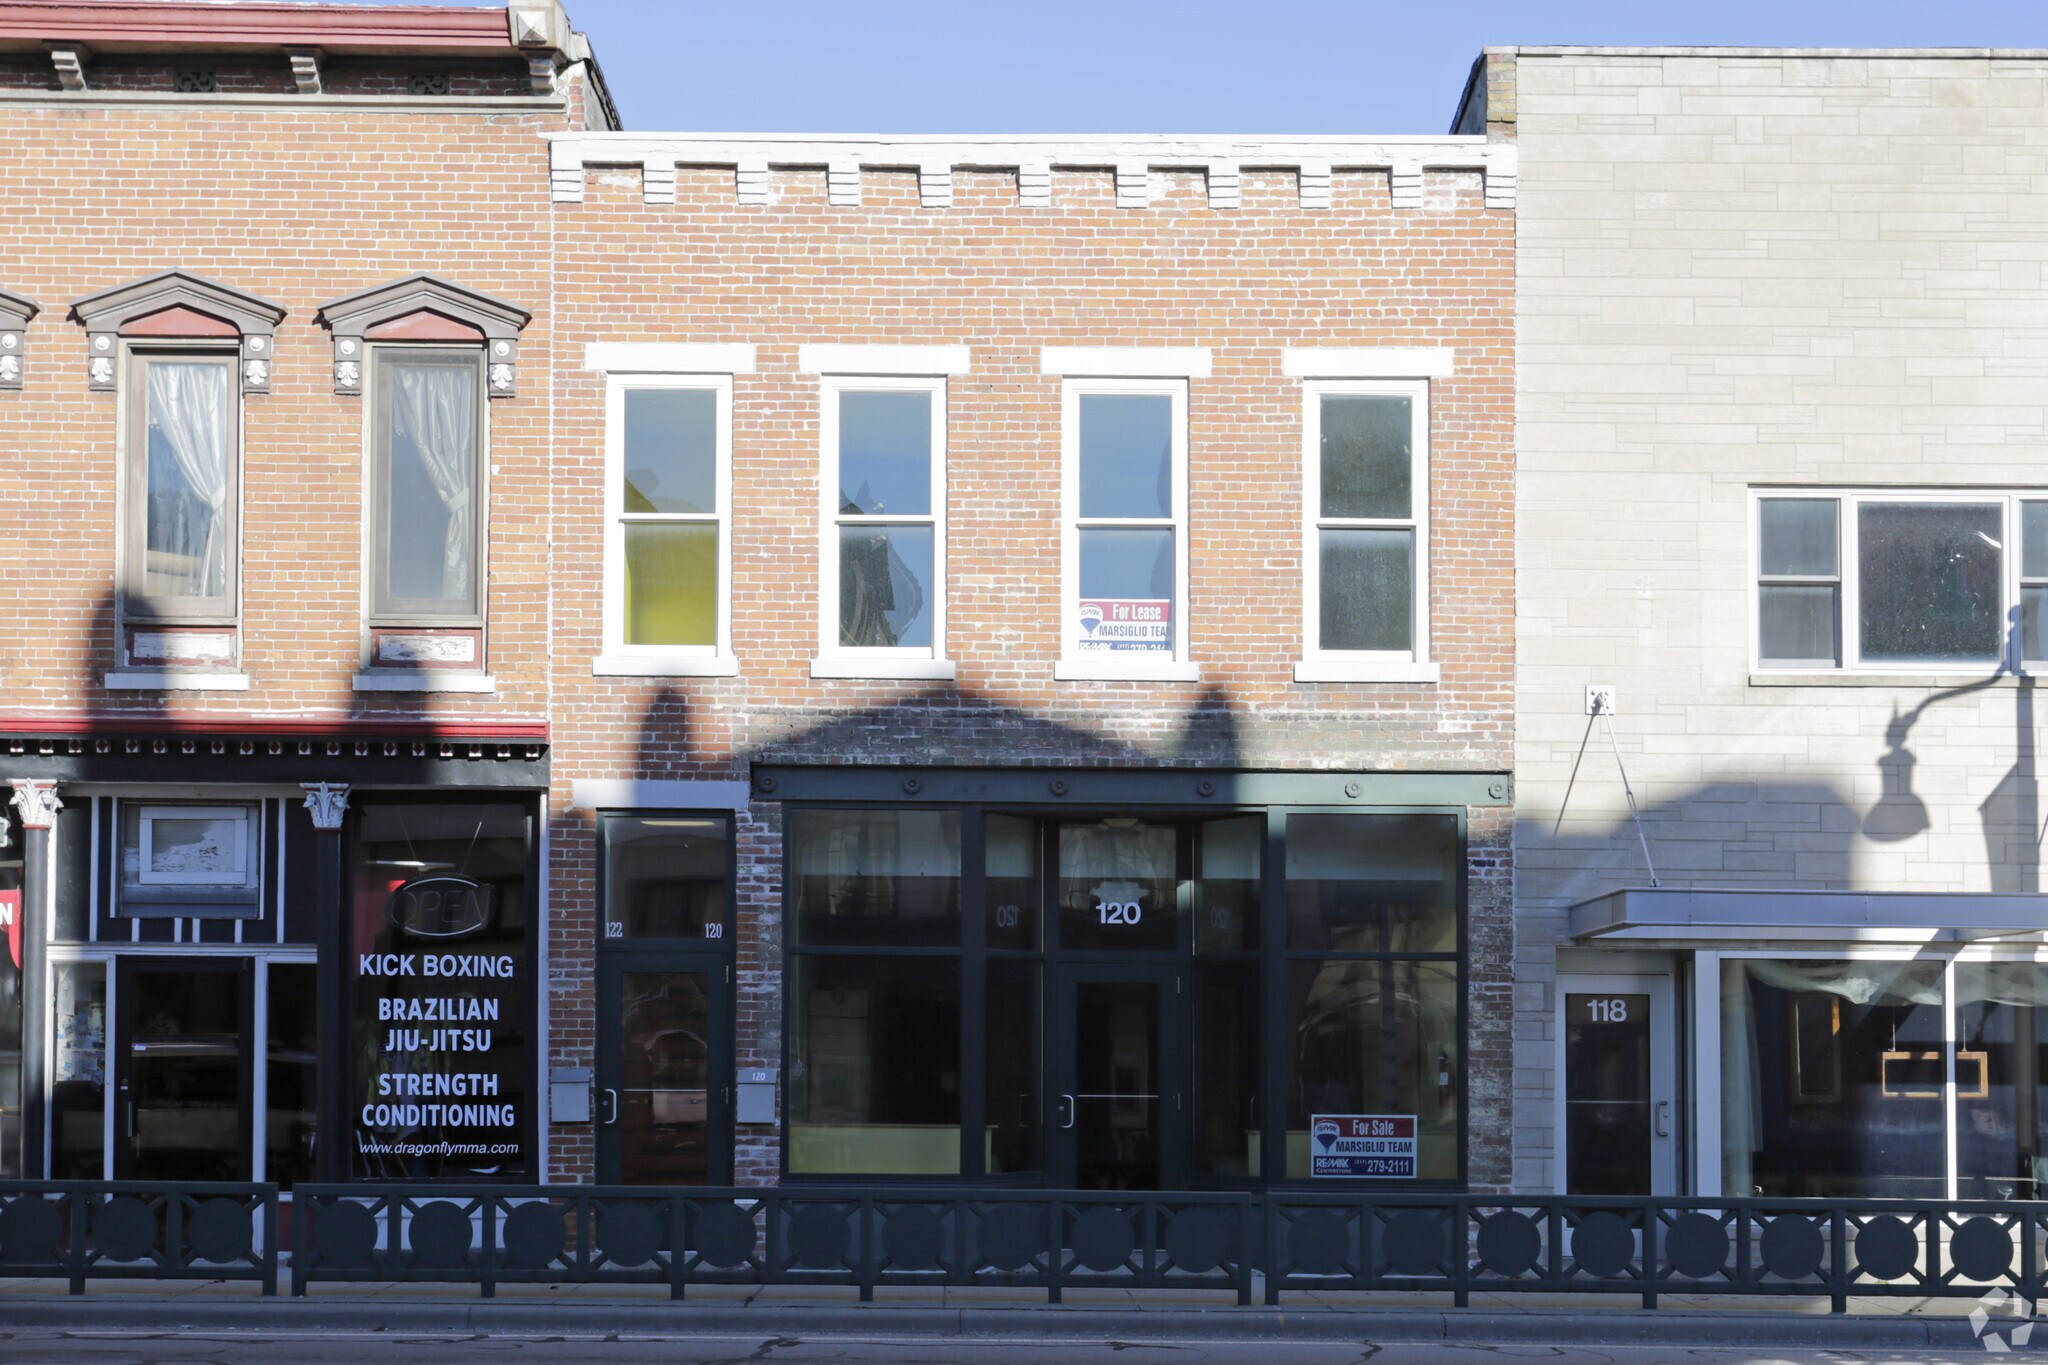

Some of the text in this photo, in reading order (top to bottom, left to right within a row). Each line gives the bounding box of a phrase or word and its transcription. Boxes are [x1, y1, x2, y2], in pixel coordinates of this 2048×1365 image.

[1112, 604, 1161, 620] For Lease
[1099, 625, 1148, 637] MARSIGLIO
[391, 890, 490, 922] OPEN
[1096, 902, 1141, 925] 120
[605, 922, 623, 938] 122
[705, 923, 722, 938] 120
[360, 954, 514, 978] KICK BOXING
[378, 998, 499, 1021] BRAZILIAN
[1587, 999, 1627, 1022] 118
[385, 1029, 491, 1051] JIU-JITSU
[378, 1073, 498, 1096] STRENGTH
[752, 1072, 766, 1081] 120
[362, 1104, 515, 1127] CONDITIONING
[1352, 1120, 1394, 1136] For Sale
[359, 1141, 519, 1157] www.dragonflymma.com
[1335, 1141, 1412, 1153] MARSIGLIO TEAM
[1316, 1158, 1349, 1168] RE/MAX
[1367, 1160, 1409, 1173] 279-2111
